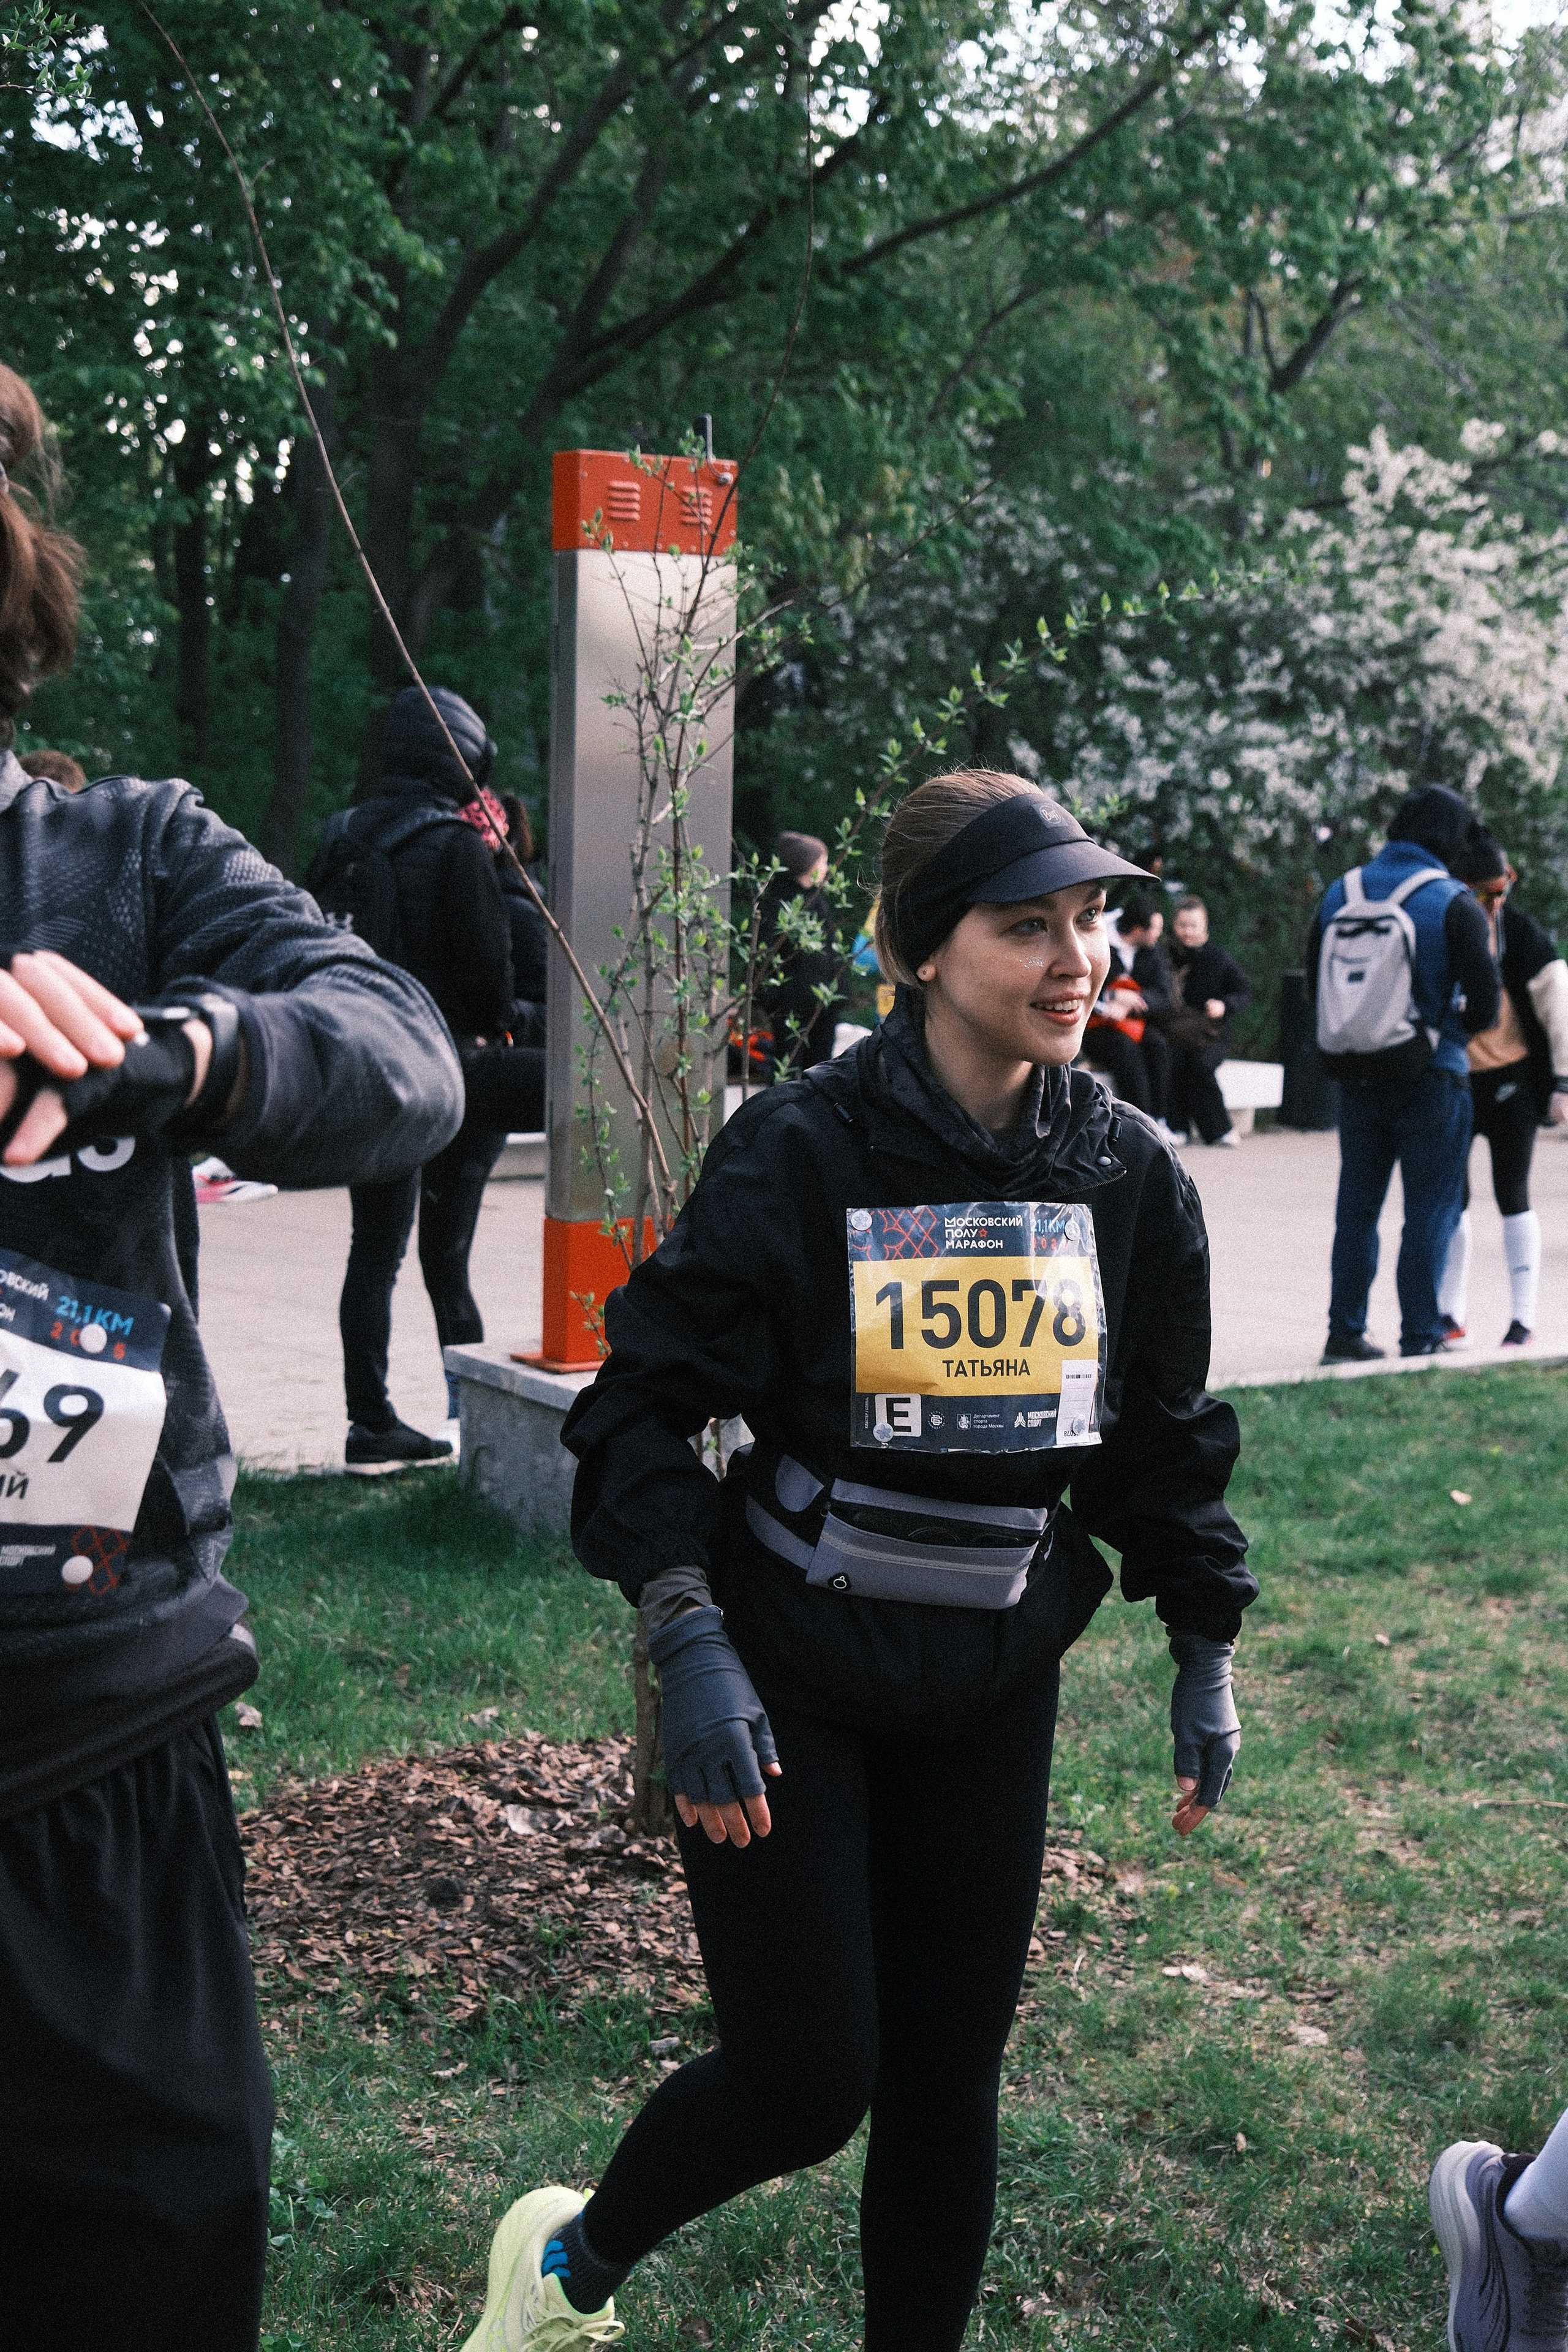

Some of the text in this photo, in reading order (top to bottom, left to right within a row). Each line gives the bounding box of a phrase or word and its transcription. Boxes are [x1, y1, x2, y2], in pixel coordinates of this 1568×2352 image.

[944, 1215, 1023, 1227] МОСКОВСКИЙ
[945, 1229, 978, 1238] ПОЛУ
[946, 1240, 1003, 1249] МАРАФОН
[876, 1280, 1086, 1349] 15078
[942, 1359, 1030, 1378] ТАТЬЯНА
